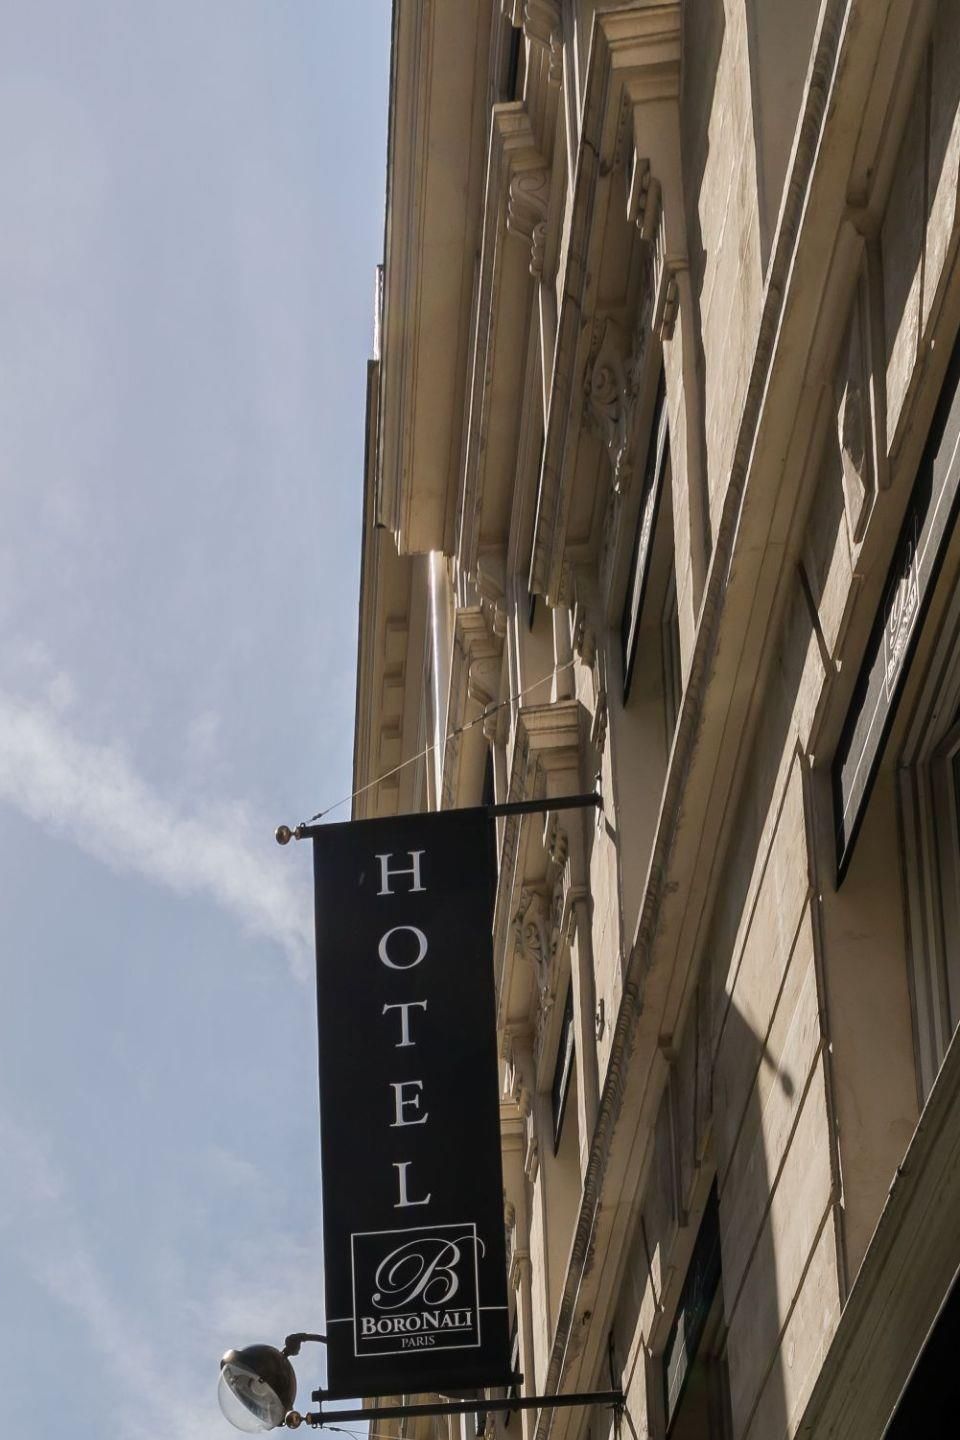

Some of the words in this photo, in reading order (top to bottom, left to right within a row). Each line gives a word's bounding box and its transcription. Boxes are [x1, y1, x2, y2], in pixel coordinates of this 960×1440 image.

[374, 849, 431, 1208] HOTEL
[371, 1235, 486, 1310] B
[401, 1335, 436, 1348] PARIS
